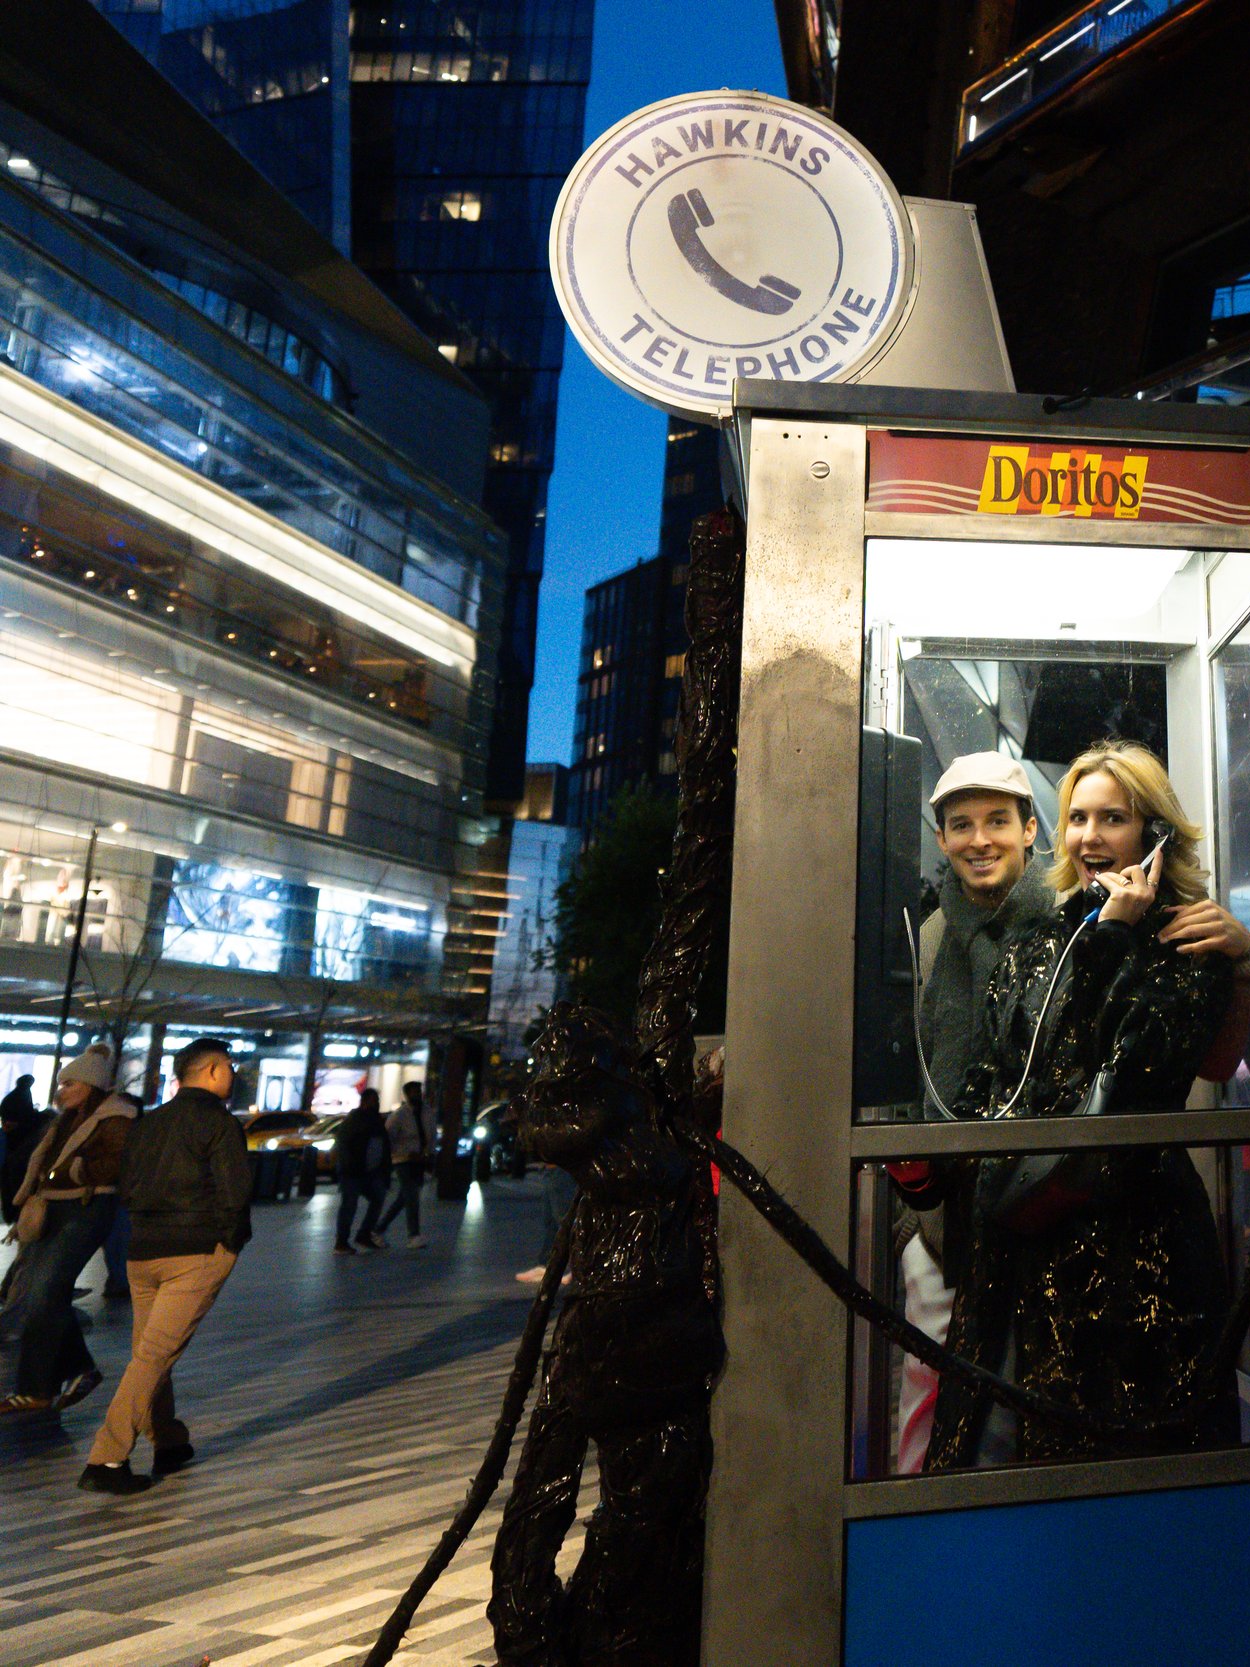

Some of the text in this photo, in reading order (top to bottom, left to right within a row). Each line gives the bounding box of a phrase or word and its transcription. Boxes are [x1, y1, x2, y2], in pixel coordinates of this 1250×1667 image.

[614, 118, 831, 189] HAWKINS
[619, 287, 877, 386] TELEPHONE
[989, 454, 1140, 509] Doritos
